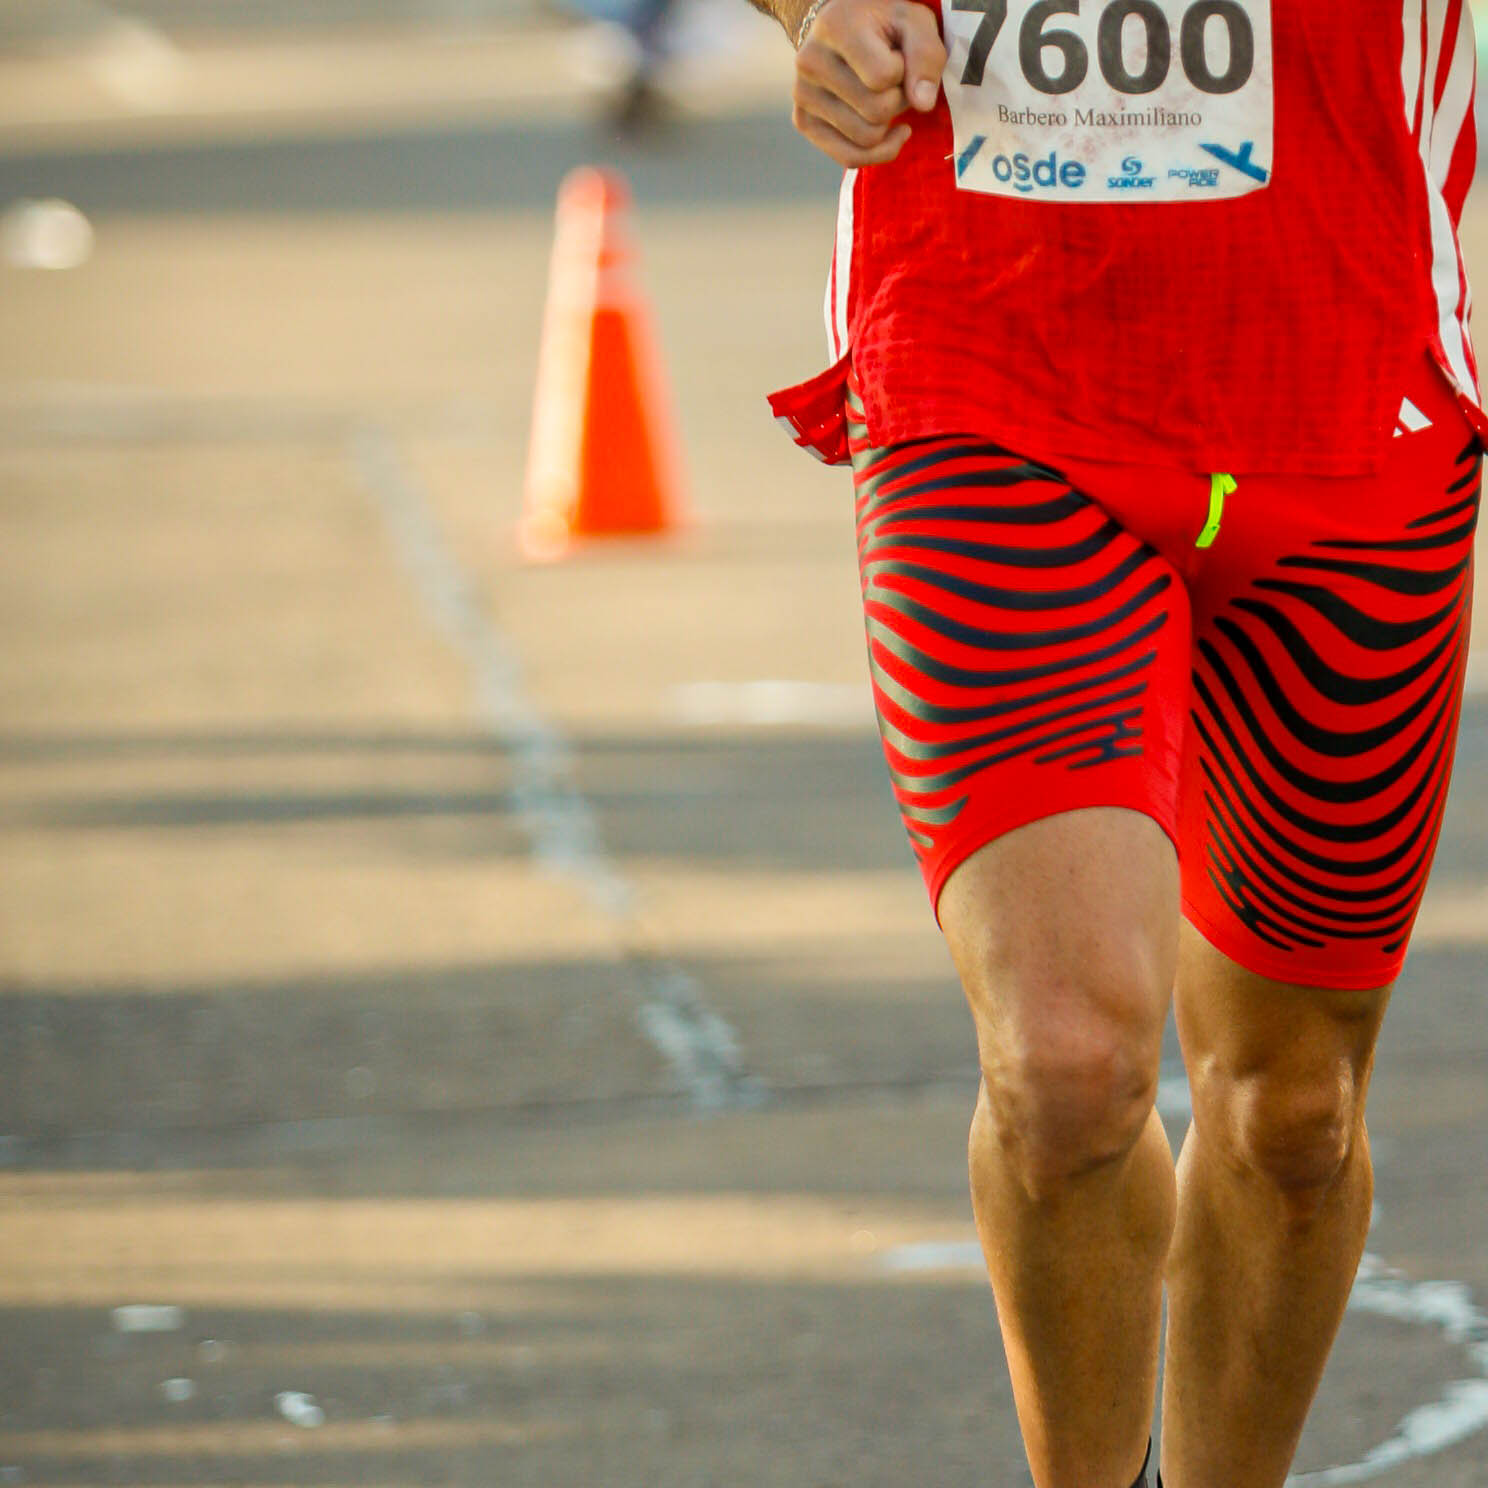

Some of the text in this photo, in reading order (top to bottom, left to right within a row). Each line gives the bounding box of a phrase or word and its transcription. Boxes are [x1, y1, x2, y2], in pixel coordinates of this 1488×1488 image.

[998, 104, 1202, 128] Barbero Maximiliano
[992, 151, 1087, 190] osde
[1167, 168, 1219, 179] POWER
